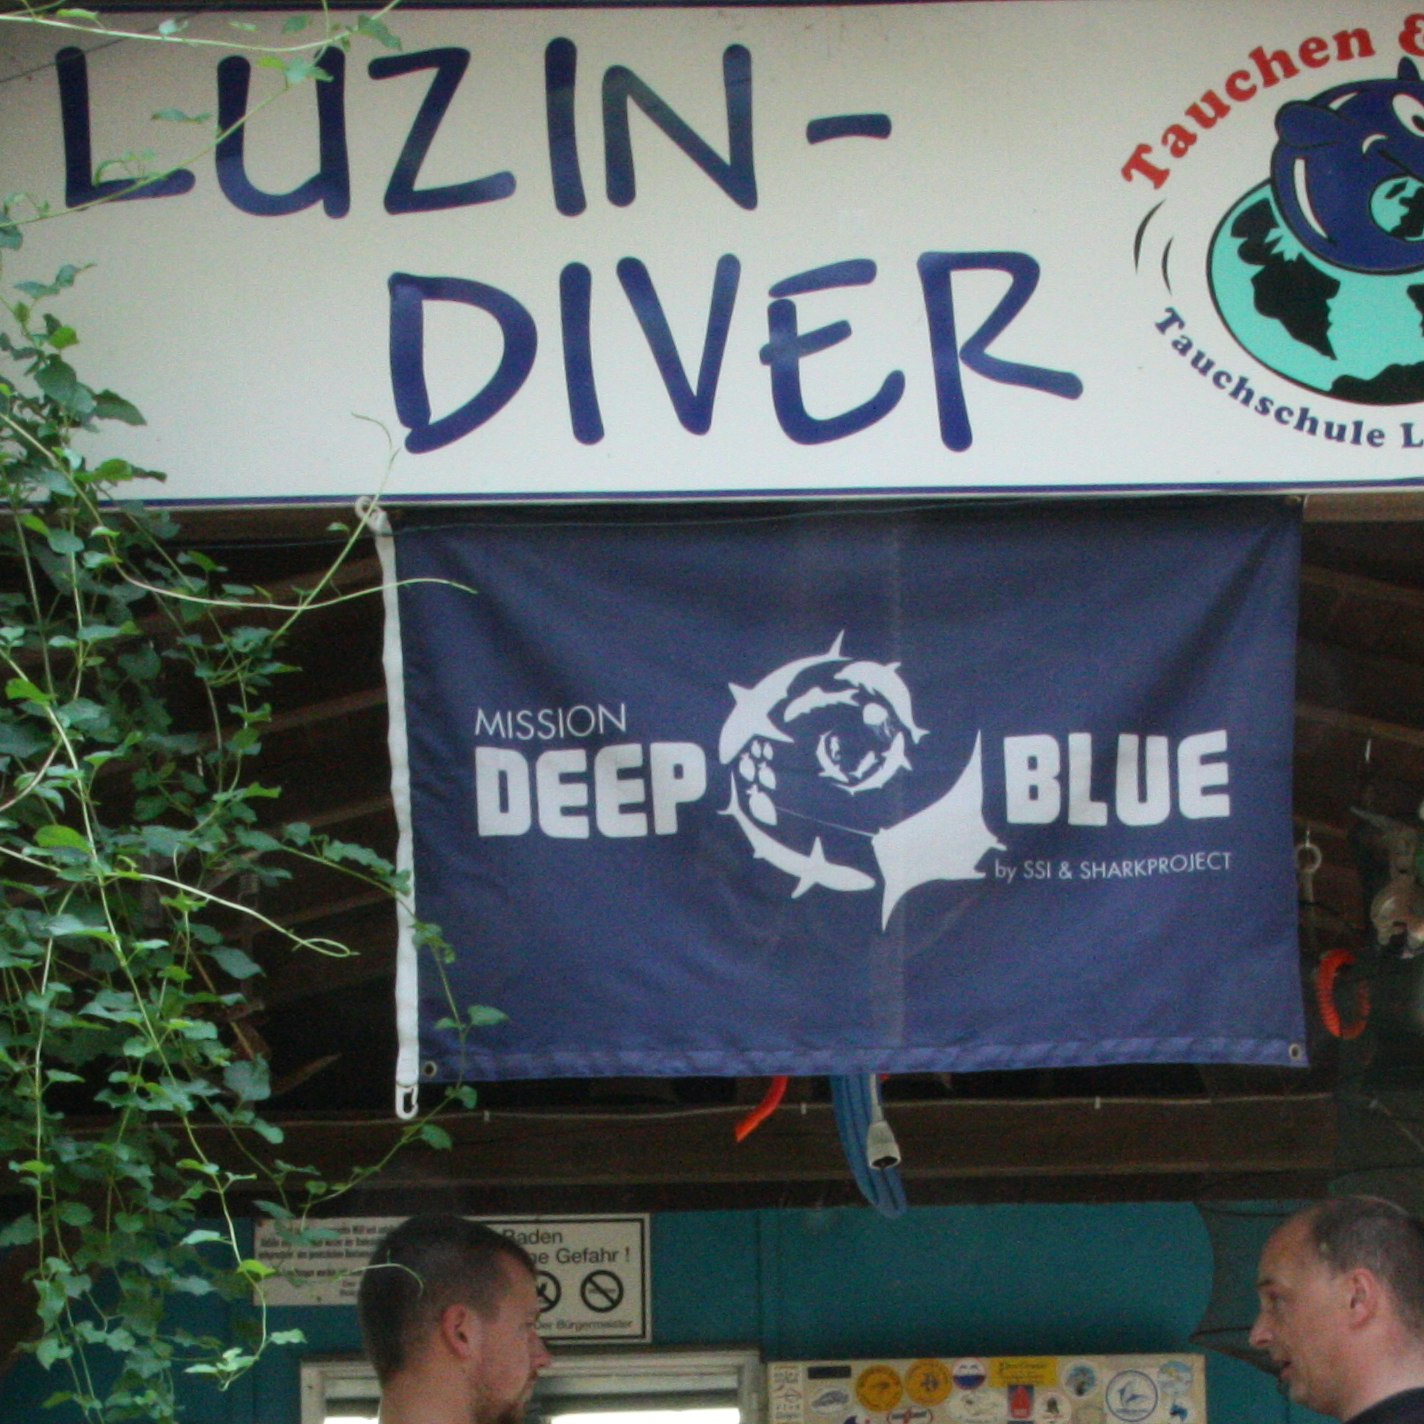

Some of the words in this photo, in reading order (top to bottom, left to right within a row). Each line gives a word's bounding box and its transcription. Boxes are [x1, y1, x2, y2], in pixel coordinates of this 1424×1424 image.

[1121, 22, 1375, 191] Tauchen
[388, 250, 1084, 454] DIVER
[1153, 307, 1386, 449] Tauchschule
[474, 703, 627, 739] MISSION
[474, 742, 707, 839] DEEP
[1003, 730, 1231, 828] BLUE
[994, 859, 1017, 885] by
[1023, 861, 1052, 881] SSI
[1057, 860, 1074, 880] &
[1079, 852, 1232, 881] SHARKPROJECT
